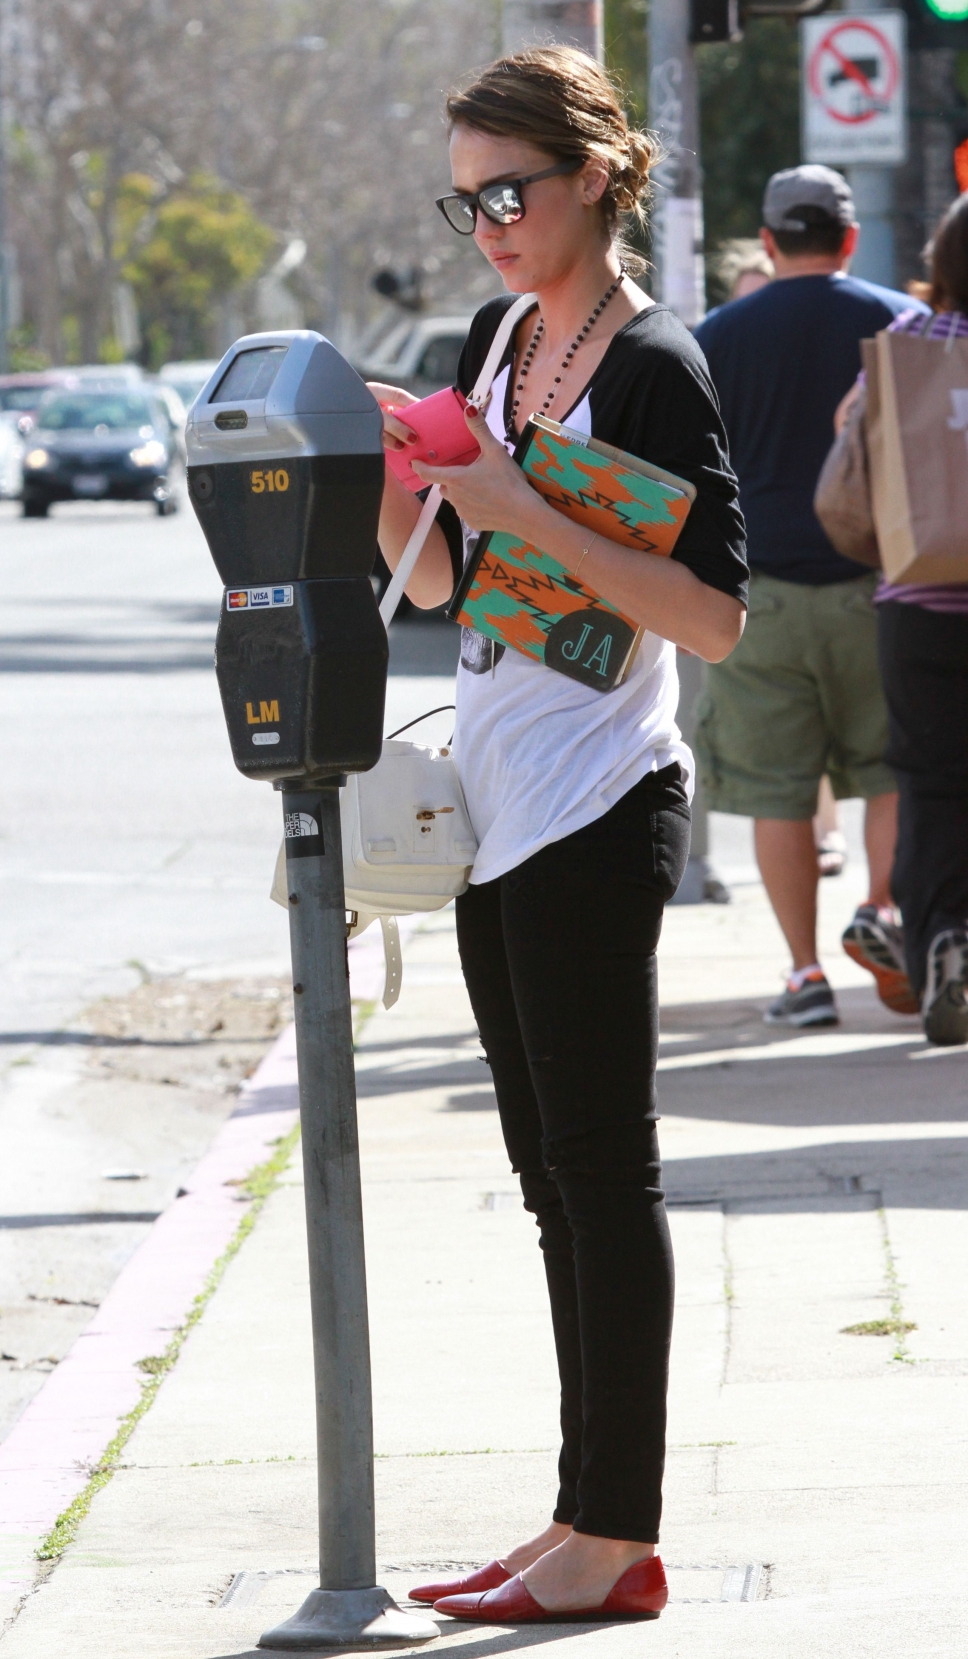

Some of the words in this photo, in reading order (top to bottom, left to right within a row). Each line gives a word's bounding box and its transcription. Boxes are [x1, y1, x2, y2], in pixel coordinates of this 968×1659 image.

[252, 469, 289, 493] 510
[253, 592, 269, 601] VISA
[561, 622, 613, 677] JA
[246, 700, 280, 724] LM
[285, 813, 300, 822] THE
